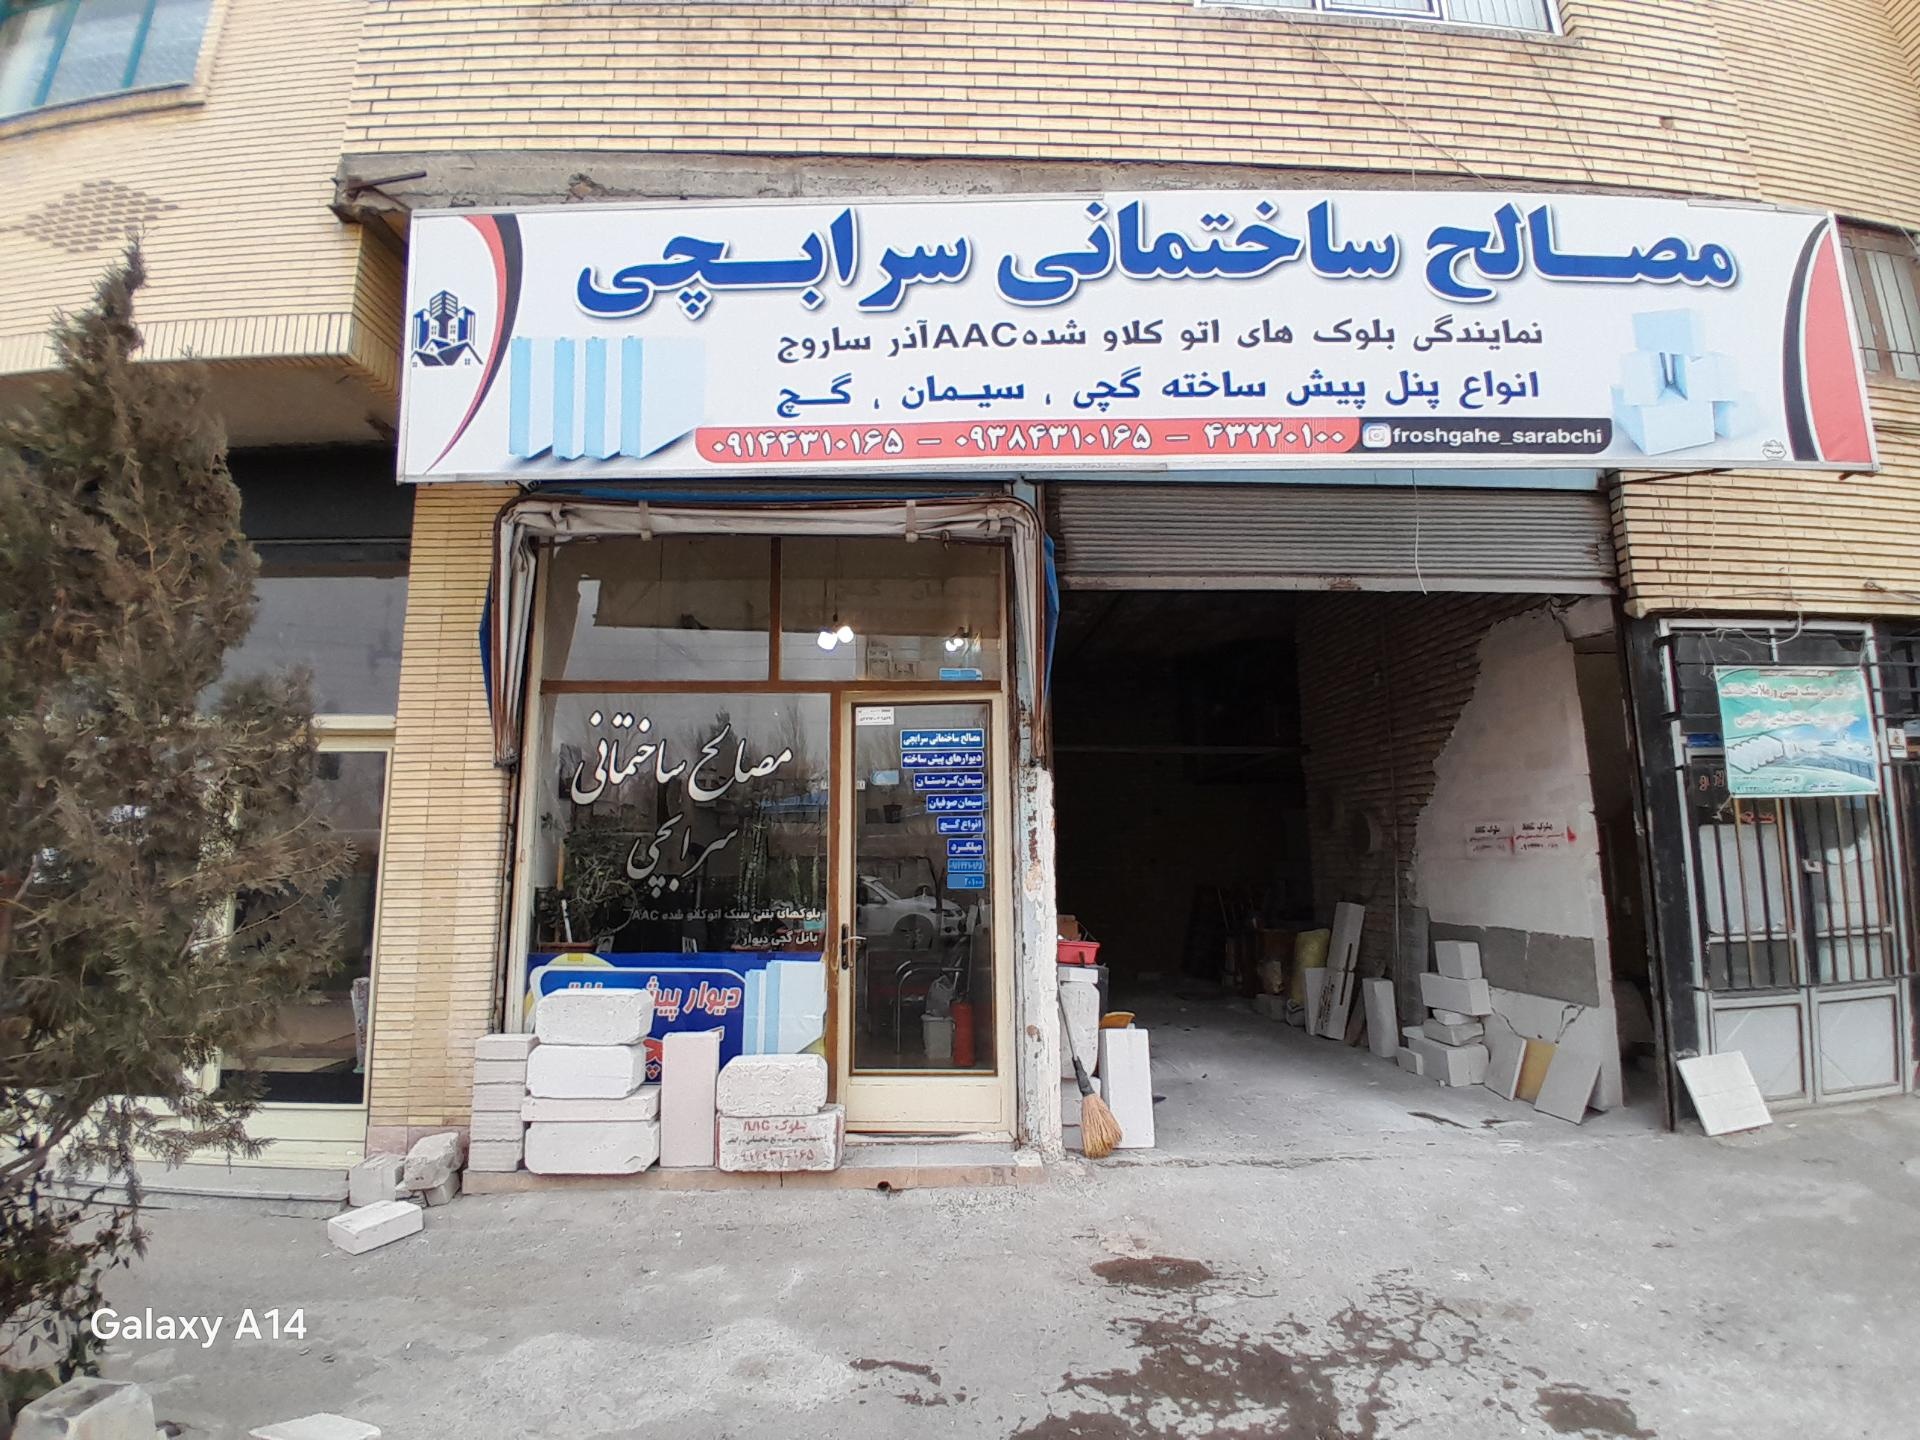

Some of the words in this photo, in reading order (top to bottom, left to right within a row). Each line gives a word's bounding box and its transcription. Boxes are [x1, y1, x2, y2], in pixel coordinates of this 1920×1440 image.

[576, 208, 967, 320] سرابچی
[998, 200, 1396, 302] ساختمانی
[1426, 204, 1734, 300] مصالح
[777, 326, 871, 364] ساروج
[1103, 319, 1163, 352] کلاو
[1180, 319, 1220, 351] اتو
[1237, 318, 1293, 348] های
[1313, 318, 1395, 350] بلوک
[1413, 314, 1543, 352] نمایندگی
[776, 372, 852, 418] گچ
[901, 375, 1024, 410] سیمان
[1073, 366, 1142, 413] گچی
[1161, 370, 1266, 398] ساخته
[1286, 369, 1366, 410] پیش
[1385, 370, 1440, 410] پنل
[1459, 370, 1539, 409] انواع
[712, 428, 904, 457] ۰۹۱۴۴۳۱۰۱۶۵
[955, 423, 1152, 450] ۰۹۳۸۴۳۱۰۱۶۵
[1203, 421, 1345, 448] ۴۳۲۲۰۱۰۰
[1393, 427, 1602, 446] froshgahe_sarabchi
[903, 733, 928, 746] سرابچی
[929, 732, 959, 745] ساختمانی
[960, 733, 981, 744] مصالح
[570, 711, 687, 805] ساختمانی
[688, 723, 793, 801] مصالح
[903, 753, 927, 763] ساخته
[927, 754, 945, 766] پیش
[945, 753, 982, 765] دیوارهای
[916, 774, 959, 787] کردستان
[957, 774, 982, 786] سیمان
[928, 796, 958, 809] صوفیان
[957, 797, 982, 809] سیمان
[940, 818, 961, 831] گچ
[960, 818, 981, 830] انواع
[626, 812, 739, 898] سرابچی
[950, 842, 982, 853] میلگرد
[632, 909, 659, 921] AAC
[661, 909, 684, 920] شده
[724, 910, 750, 922] سبک
[776, 908, 821, 922] بلوکهای
[682, 980, 741, 1015] دیوار
